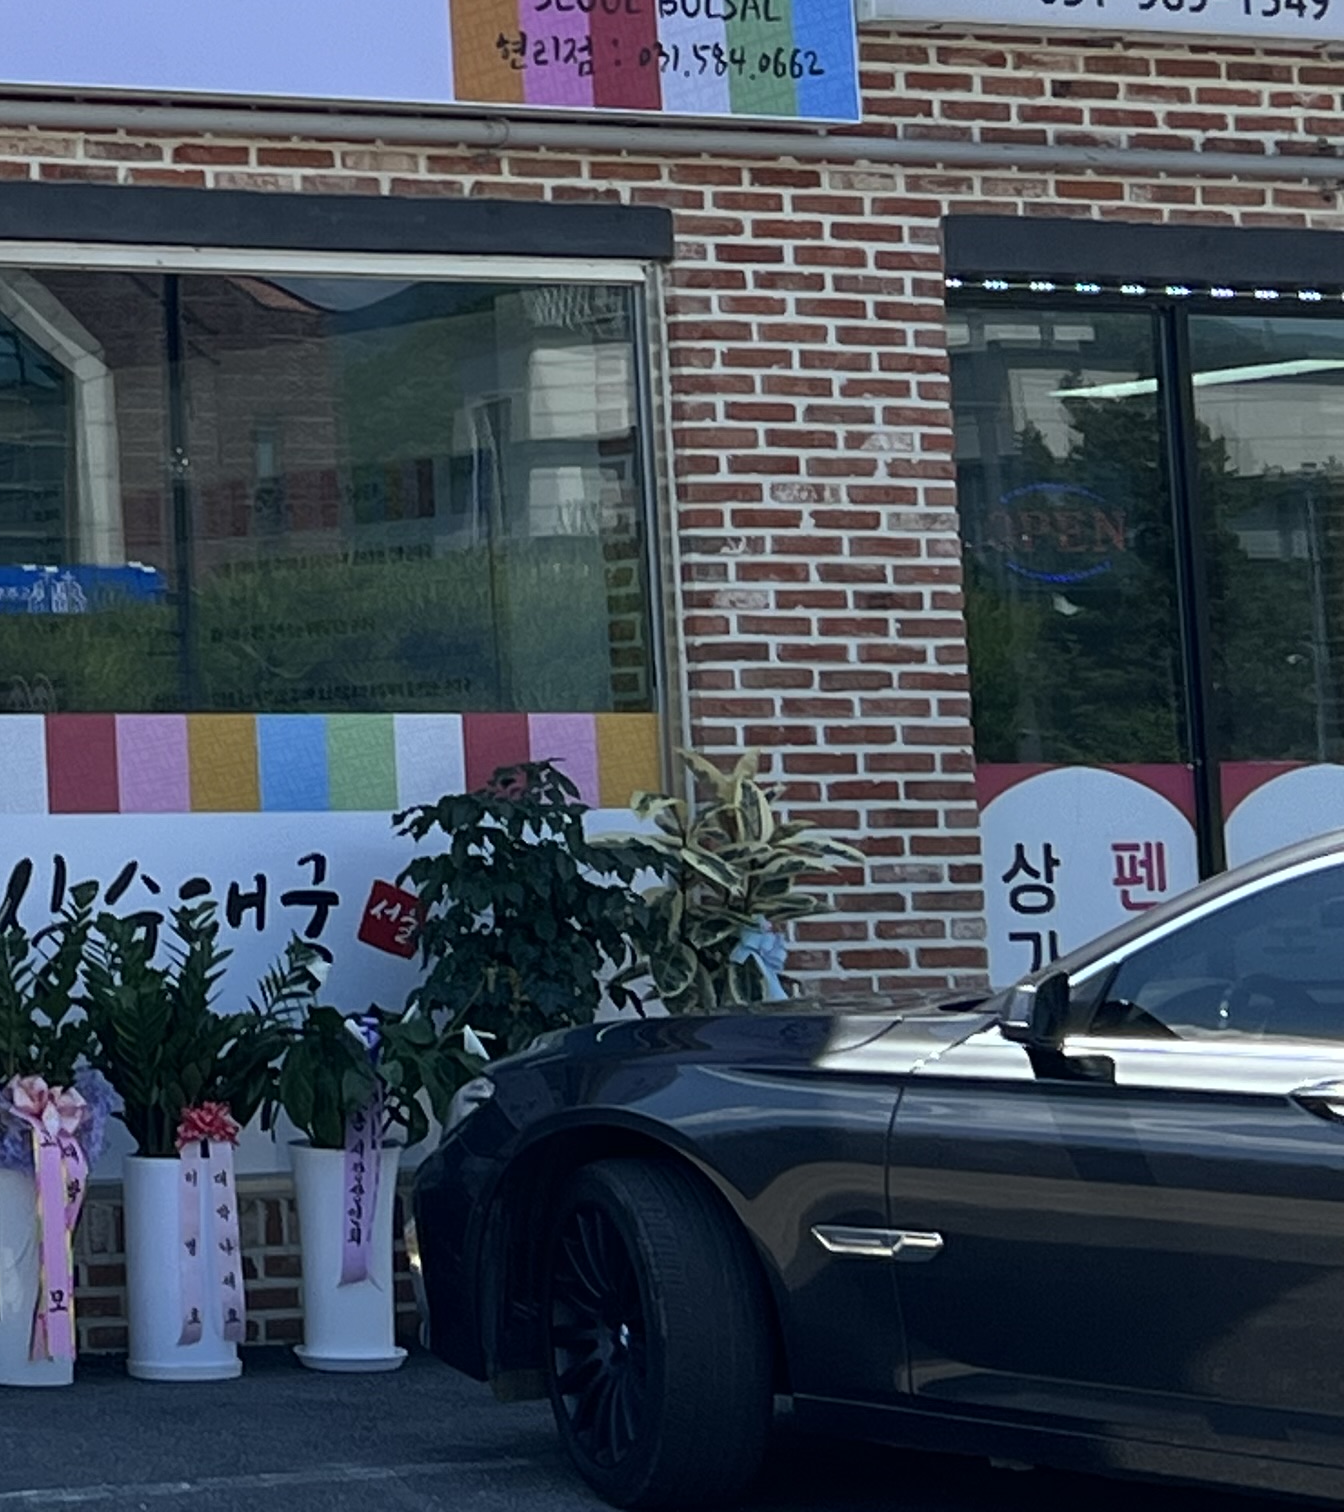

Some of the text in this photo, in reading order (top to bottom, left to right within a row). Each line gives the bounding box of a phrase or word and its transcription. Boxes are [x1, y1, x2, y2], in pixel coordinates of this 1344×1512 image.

[497, 30, 594, 76] 현리점
[639, 40, 825, 80] 031.584.0662
[985, 508, 1126, 553] OPEN
